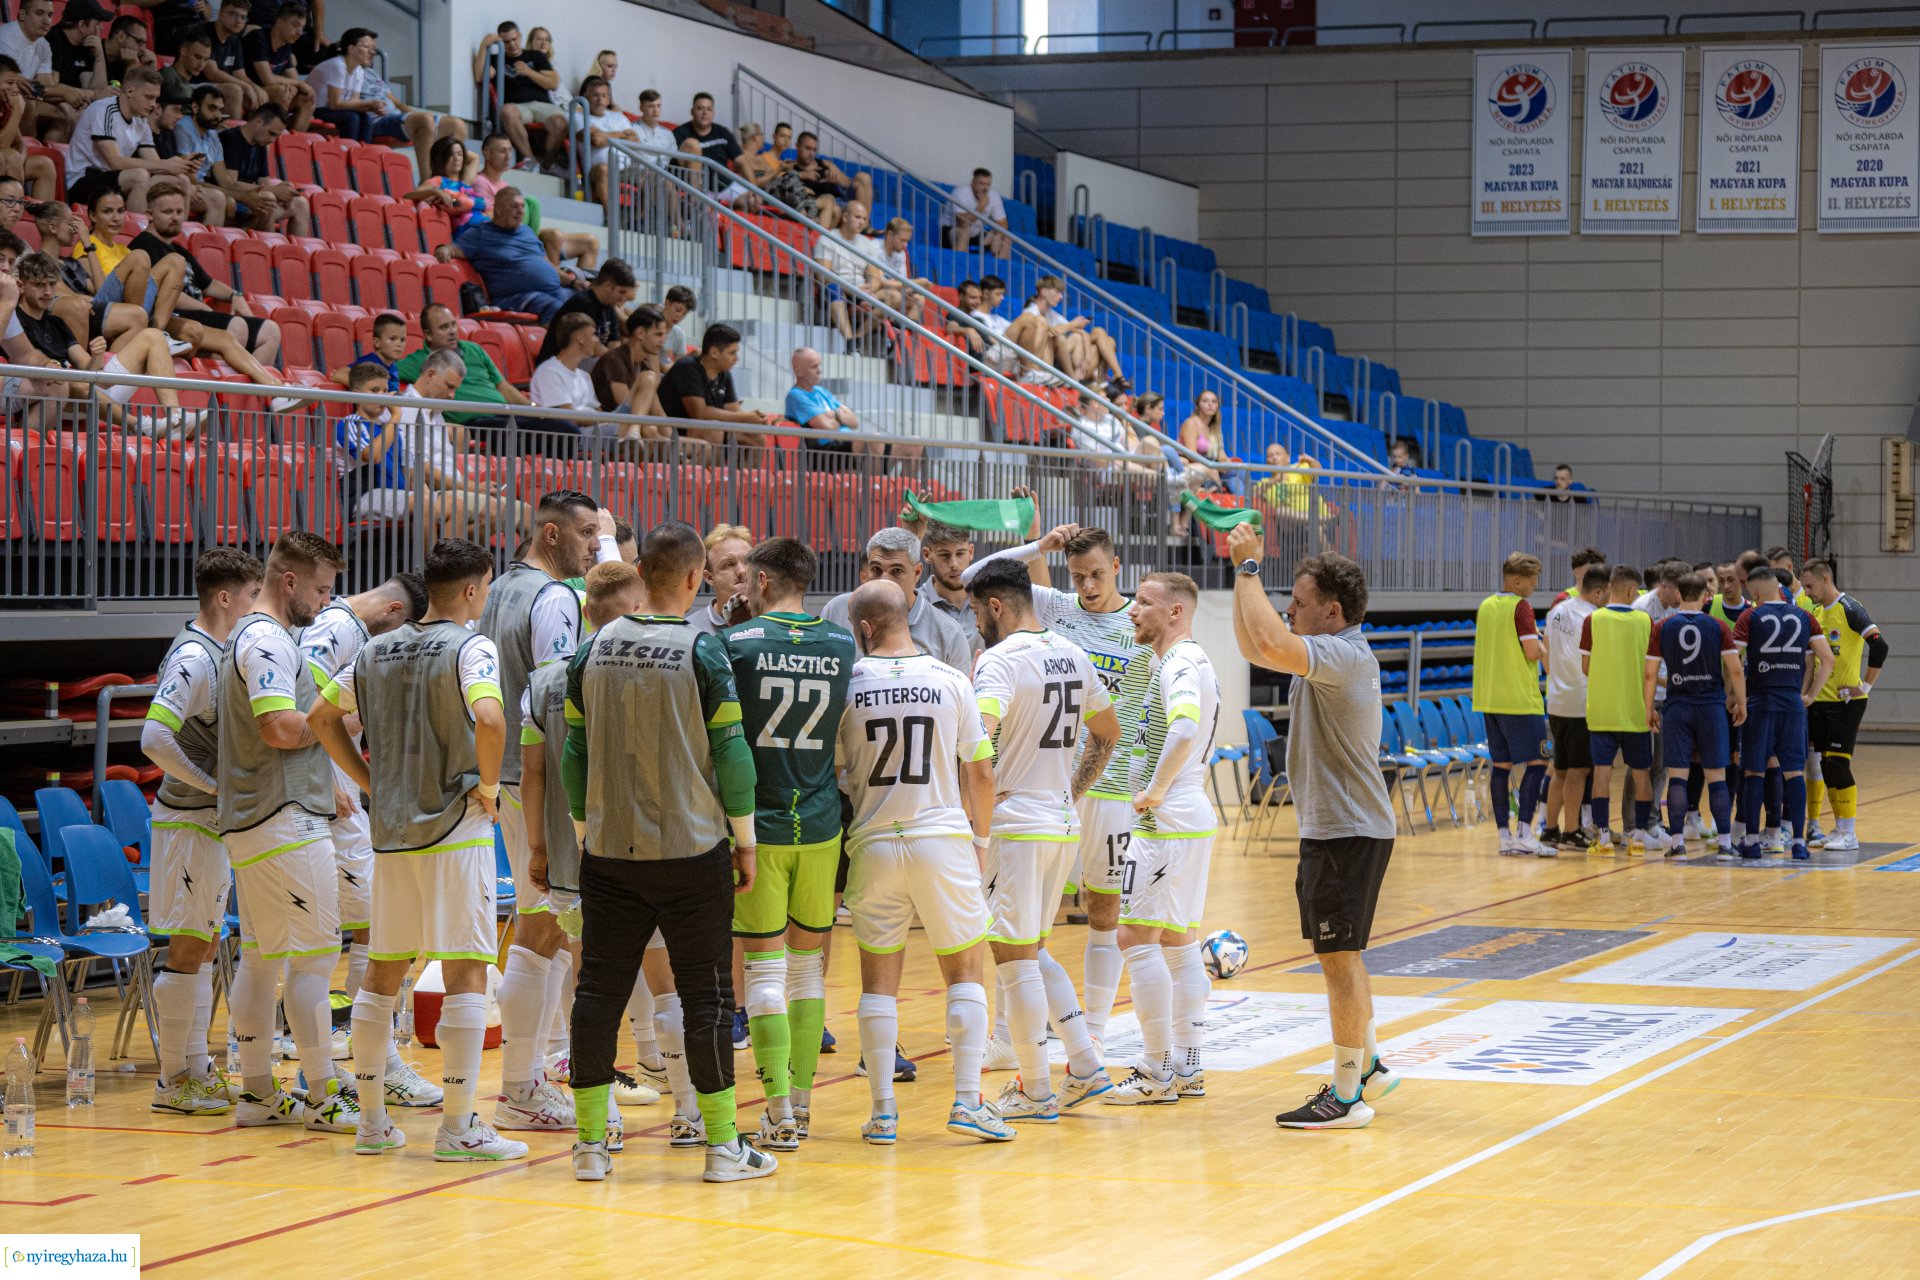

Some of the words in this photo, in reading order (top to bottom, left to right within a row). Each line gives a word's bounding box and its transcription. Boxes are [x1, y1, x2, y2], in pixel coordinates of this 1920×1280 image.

[1506, 64, 1539, 77] FATUM
[1605, 65, 1649, 88] FATUM
[1721, 63, 1765, 87] FATUM
[1840, 60, 1884, 85] FATUM
[1619, 135, 1666, 145] RÖPLABDA
[1734, 133, 1783, 142] RÖPLABDA
[1855, 132, 1904, 141] RÖPLABDA
[1502, 147, 1541, 156] CSAPATA
[1613, 146, 1652, 155] CSAPATA
[1729, 144, 1769, 153] CSAPATA
[1849, 143, 1890, 151] CSAPATA
[1509, 164, 1534, 176] 2023
[1619, 162, 1644, 175] 2021
[1736, 161, 1761, 173] 2021
[1856, 159, 1883, 171] 2020
[1484, 181, 1527, 193] MAGYAR
[1530, 180, 1559, 192] KUPA
[1592, 178, 1625, 189] MAGYAR
[1626, 174, 1673, 190] BAJNOKSÁG
[1710, 178, 1754, 189] MAGYAR
[1757, 178, 1787, 189] KUPA
[1830, 177, 1876, 188] MAGYAR
[1879, 176, 1909, 187] KUPA
[1481, 201, 1498, 214] III.
[1501, 196, 1562, 213] HELYEZÉS
[1593, 199, 1602, 212] I.
[1605, 195, 1669, 212] HELYEZÉS
[1709, 198, 1718, 210] I.
[1721, 194, 1786, 210] HELYEZÉS
[1828, 198, 1841, 210] II.
[1844, 193, 1911, 209] HELYEZÉS
[1760, 614, 1802, 653] 22
[388, 641, 448, 655] Zeus
[618, 641, 685, 661] Zeus
[1678, 624, 1702, 665] 9
[636, 660, 654, 669] gli
[657, 662, 681, 671] dei
[756, 652, 840, 676] ALASZTICS
[1043, 657, 1077, 676] ARNON
[1086, 652, 1128, 674] MIX
[855, 687, 942, 709] PETTERSON
[756, 676, 831, 750] 22
[1039, 680, 1083, 749] 25
[864, 715, 935, 787] 20
[1107, 832, 1131, 866] 13
[1475, 1009, 1679, 1058] TAKARÉK
